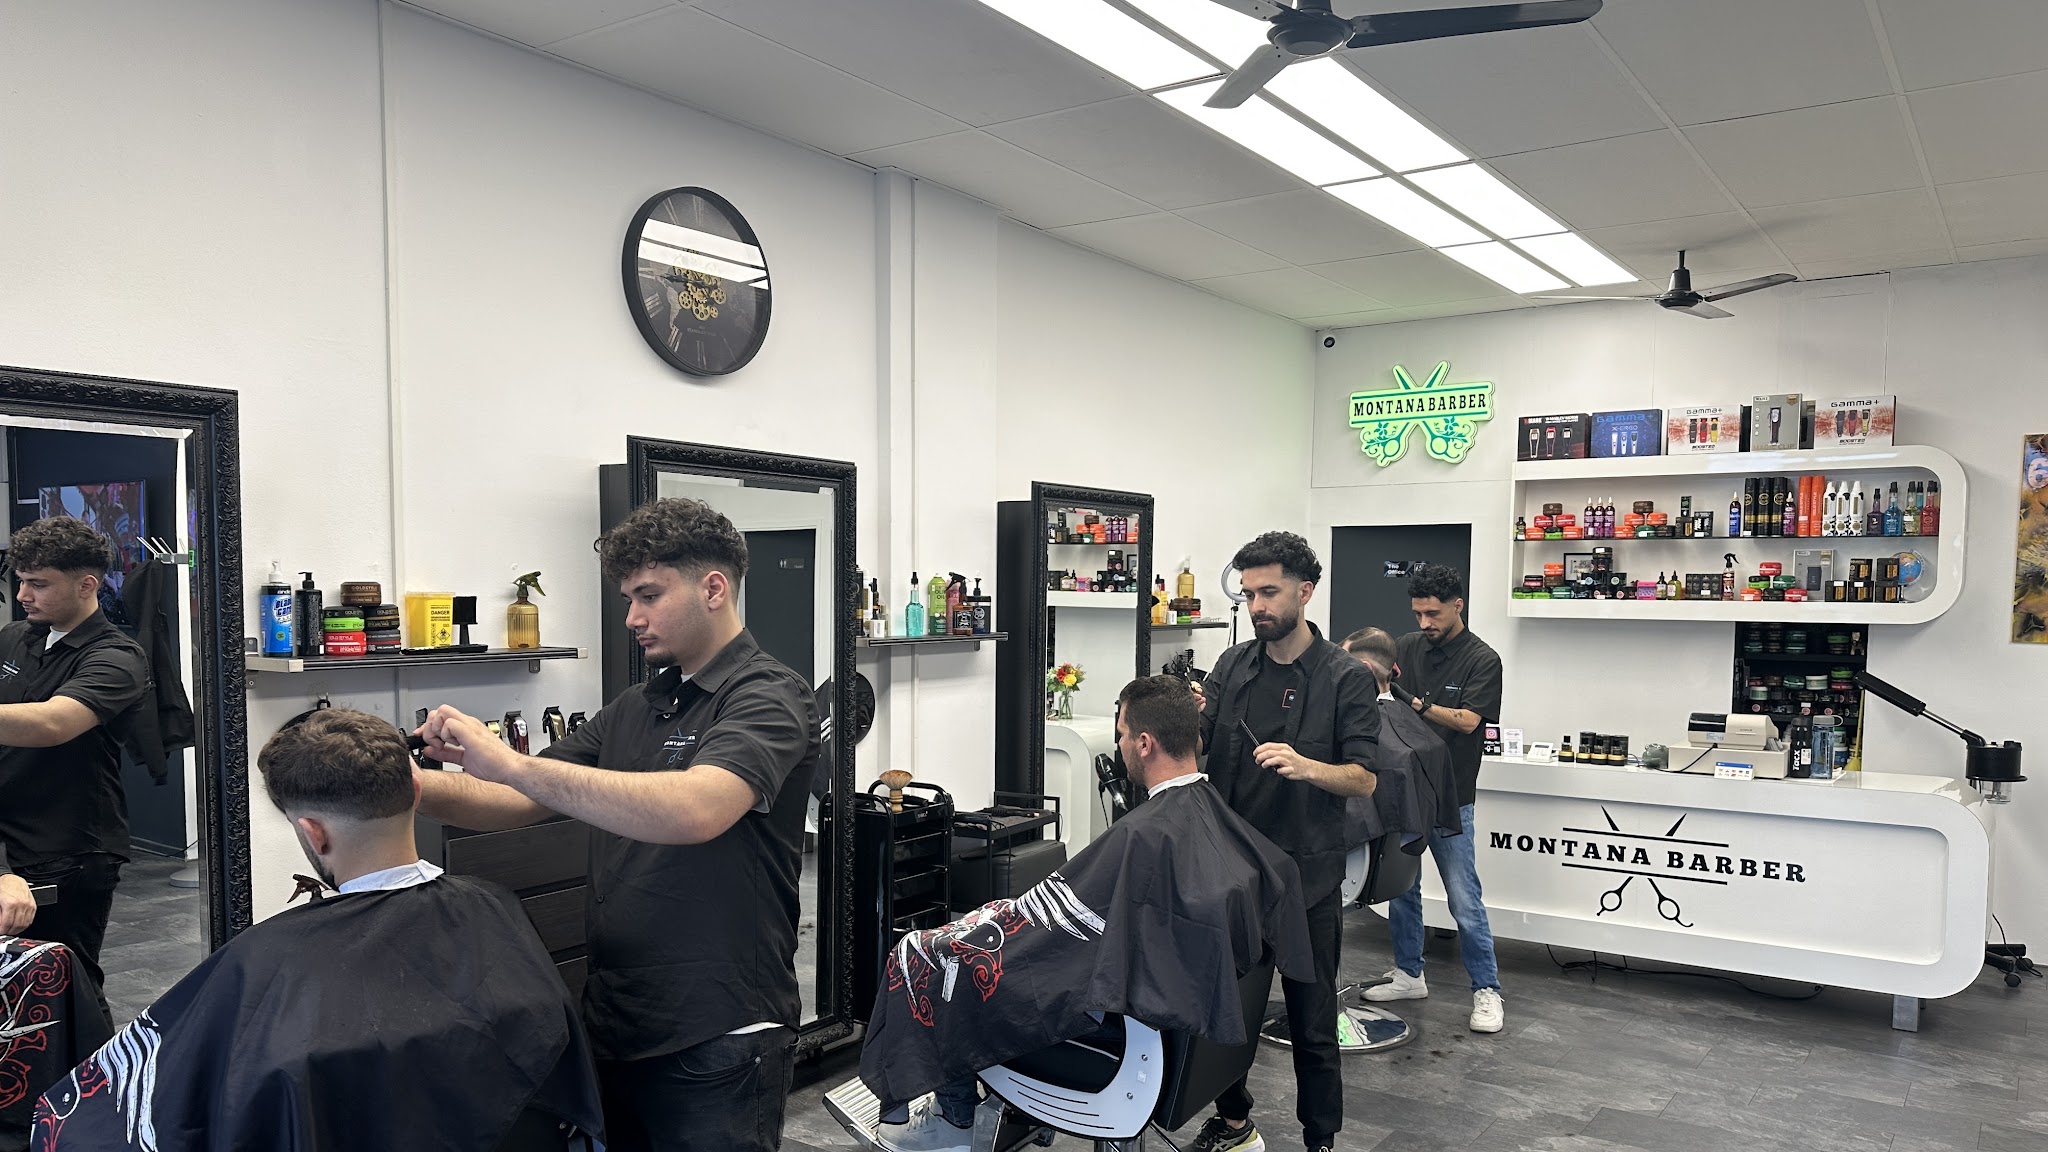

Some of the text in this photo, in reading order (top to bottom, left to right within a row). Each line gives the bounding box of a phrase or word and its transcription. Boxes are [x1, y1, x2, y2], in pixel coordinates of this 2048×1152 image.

[1792, 750, 1801, 771] Tacx
[1490, 831, 1806, 882] MONTANA BARBER
